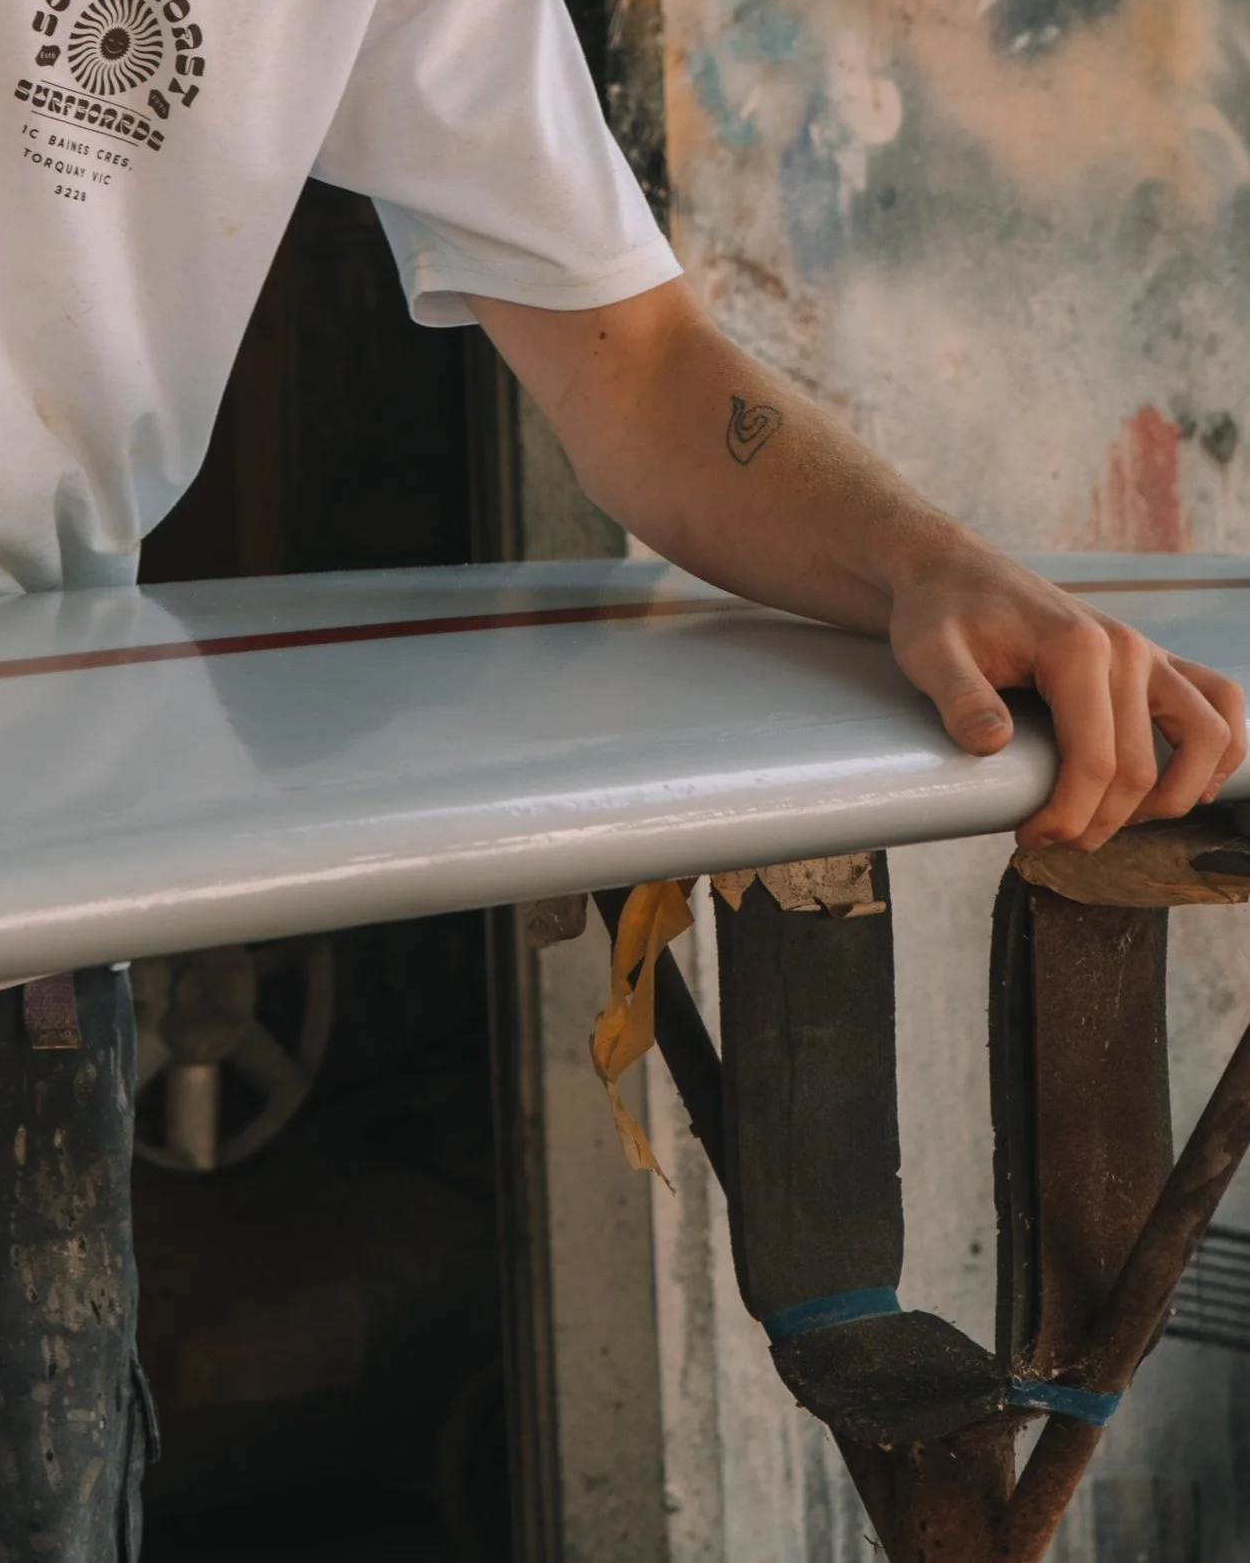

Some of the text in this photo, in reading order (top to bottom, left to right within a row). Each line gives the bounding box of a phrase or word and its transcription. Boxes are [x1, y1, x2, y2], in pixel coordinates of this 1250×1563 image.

[14, 79, 165, 151] SURFBOARDS
[22, 124, 133, 171] 1C BAINES CRES.
[23, 148, 111, 185] TORQUAY VIC
[54, 184, 87, 202] 3228
